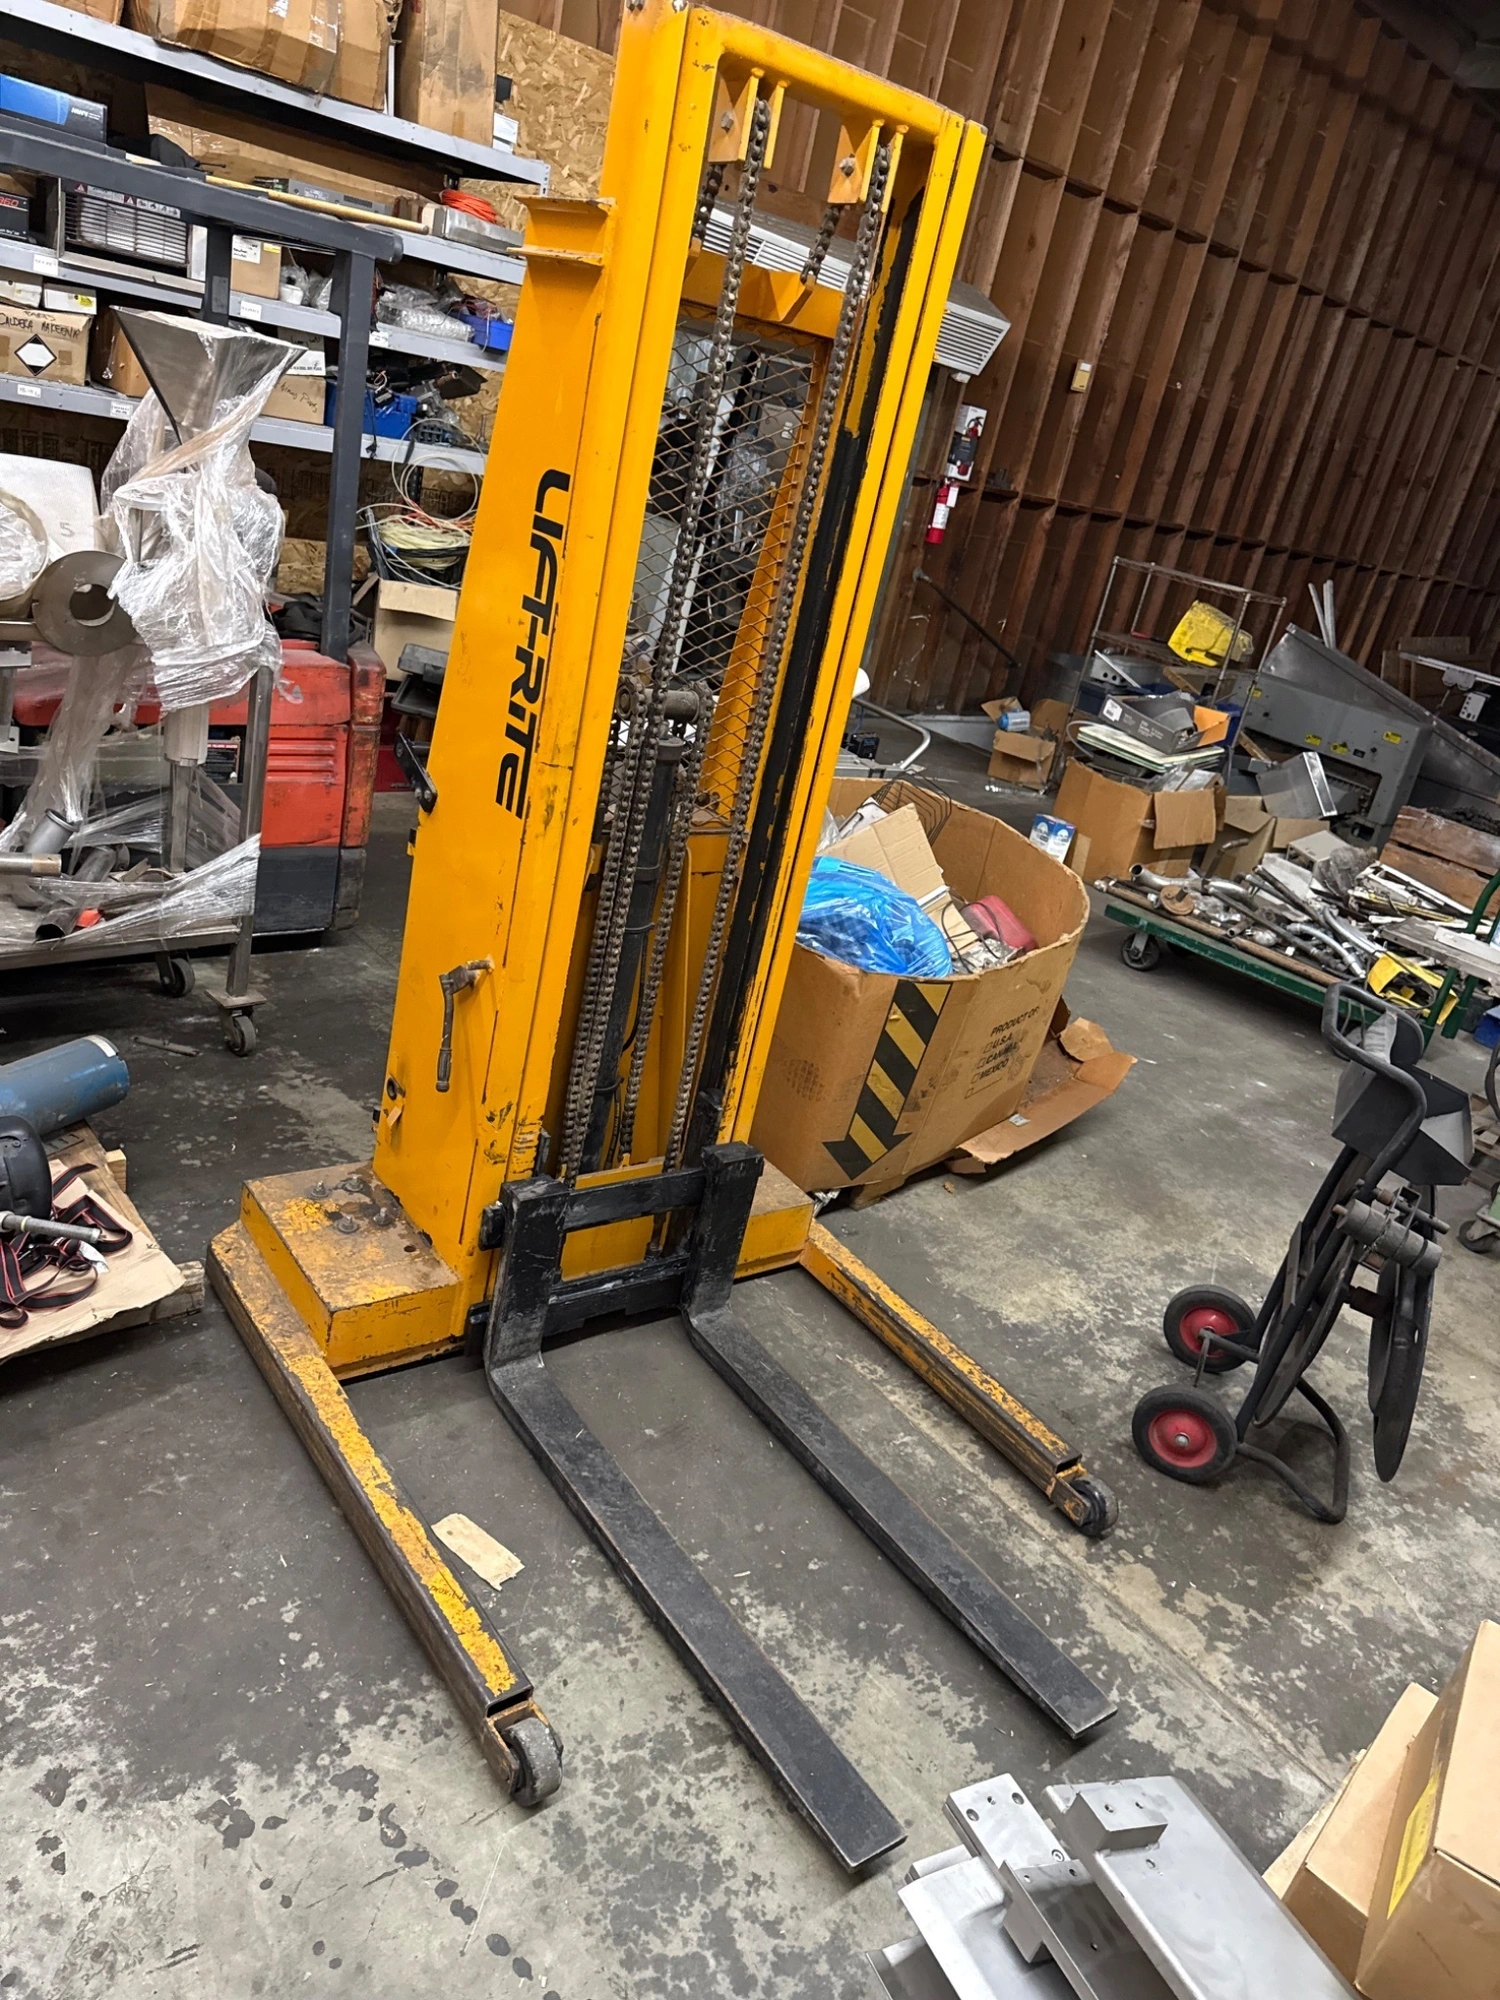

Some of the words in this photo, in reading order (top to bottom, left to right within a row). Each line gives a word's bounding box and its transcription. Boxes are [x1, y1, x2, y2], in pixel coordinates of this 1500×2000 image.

[495, 469, 571, 820] LIFT-RITE
[990, 1012, 1028, 1037] PRODUCT
[979, 1058, 1009, 1080] MEXICO
